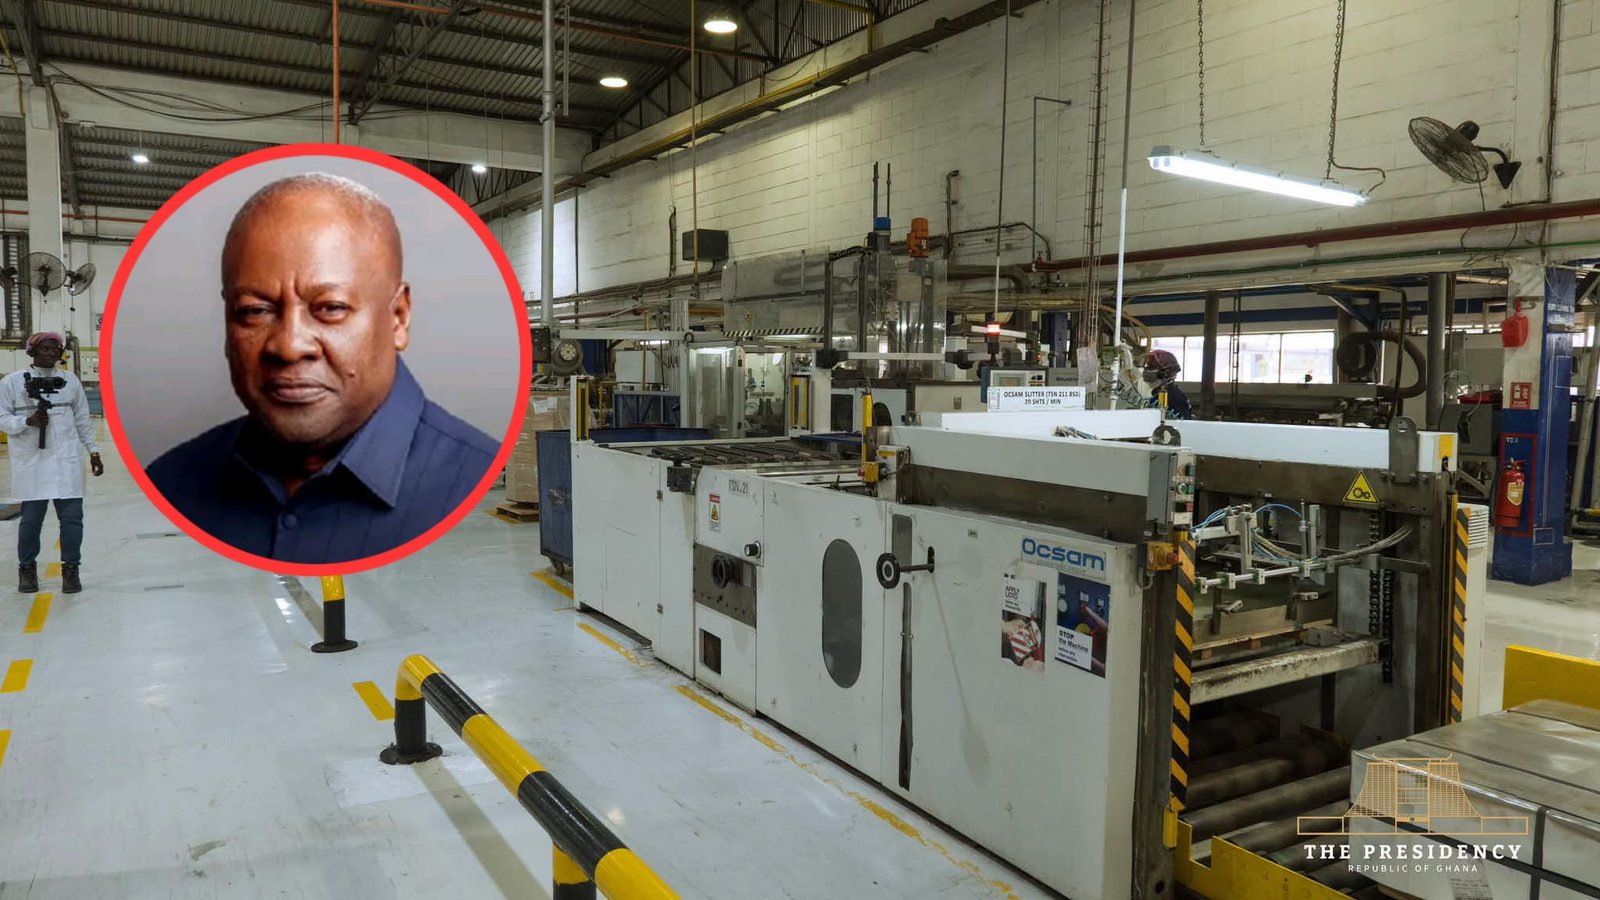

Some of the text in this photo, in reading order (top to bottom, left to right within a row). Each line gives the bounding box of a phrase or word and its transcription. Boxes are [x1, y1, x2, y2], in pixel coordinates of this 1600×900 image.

[1005, 585, 1021, 594] APPLY
[1059, 630, 1075, 640] STOP
[1067, 640, 1089, 653] Machine
